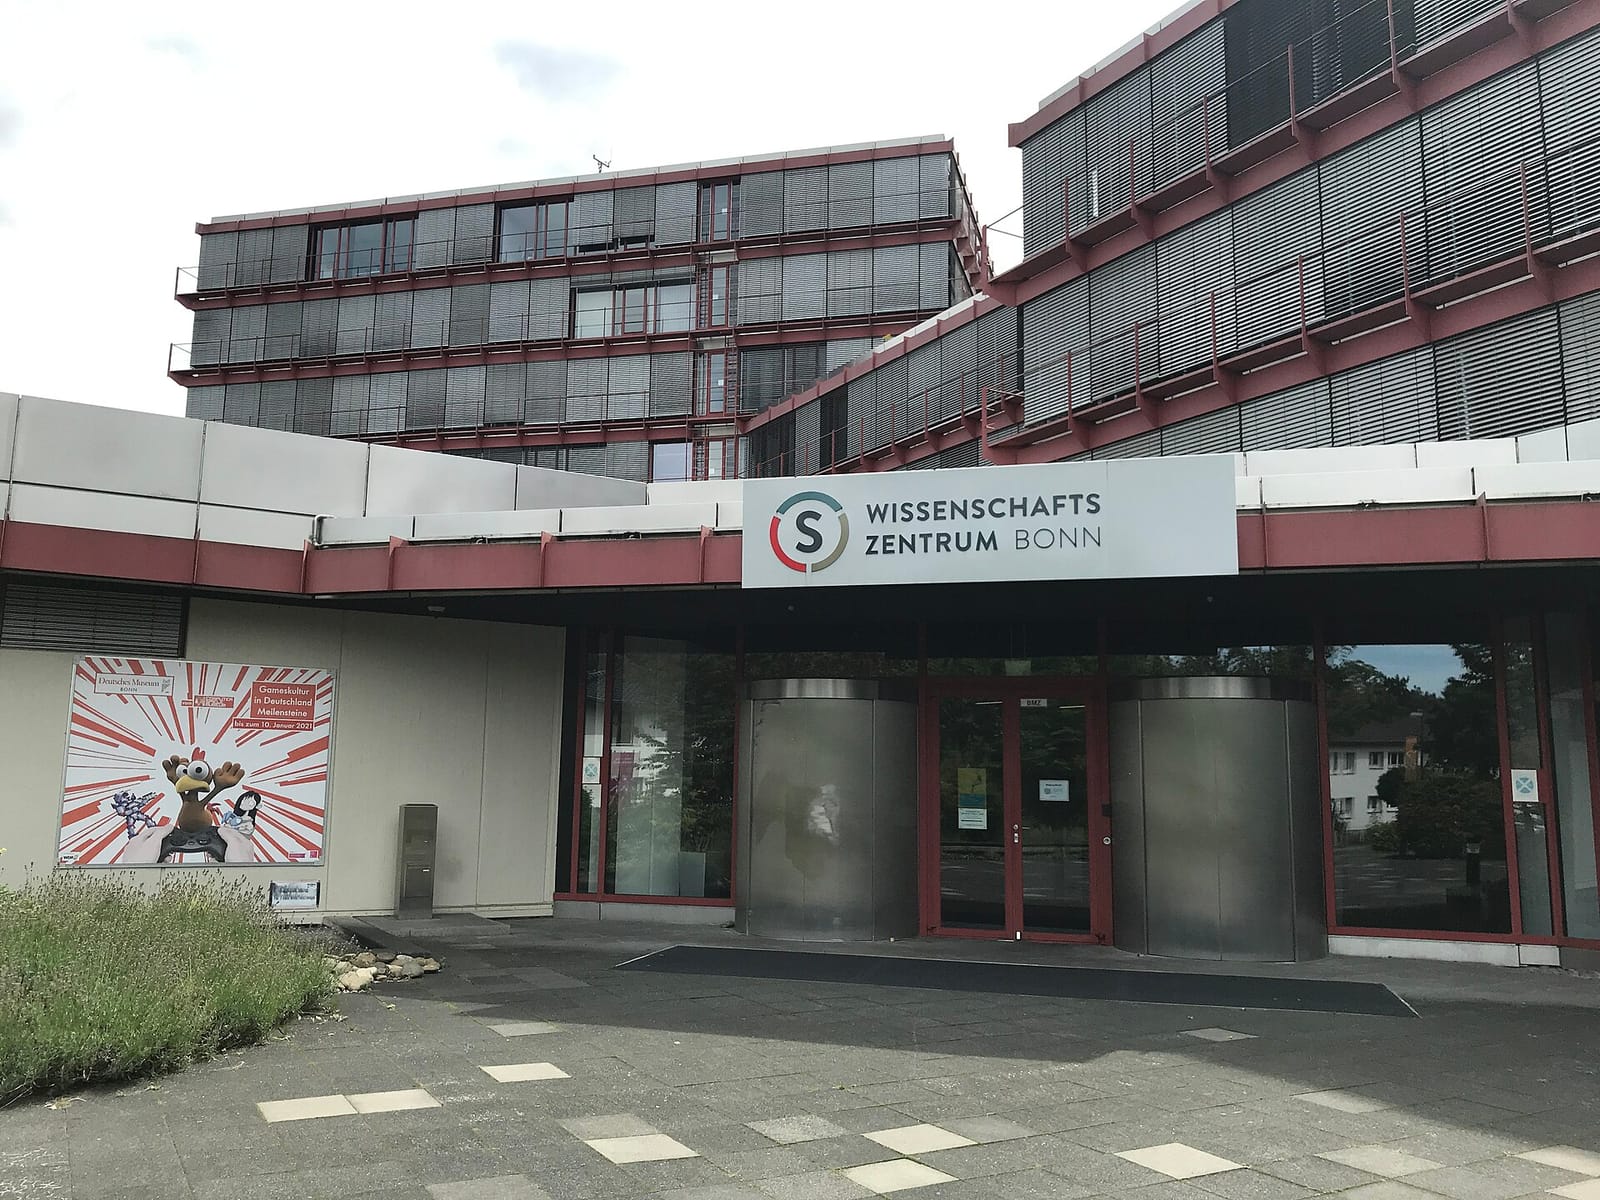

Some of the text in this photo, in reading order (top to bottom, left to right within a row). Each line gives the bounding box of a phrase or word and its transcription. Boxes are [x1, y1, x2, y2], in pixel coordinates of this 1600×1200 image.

[866, 493, 1101, 524] WISSENSCHAFTS
[865, 526, 1101, 555] ZENTRUM BONN
[98, 677, 131, 686] Deutsches
[131, 678, 160, 687] Museum
[258, 685, 310, 695] Gameskultur
[253, 696, 313, 707] in Deutschland
[257, 707, 308, 717] Meilensteine
[272, 721, 295, 729] Januar
